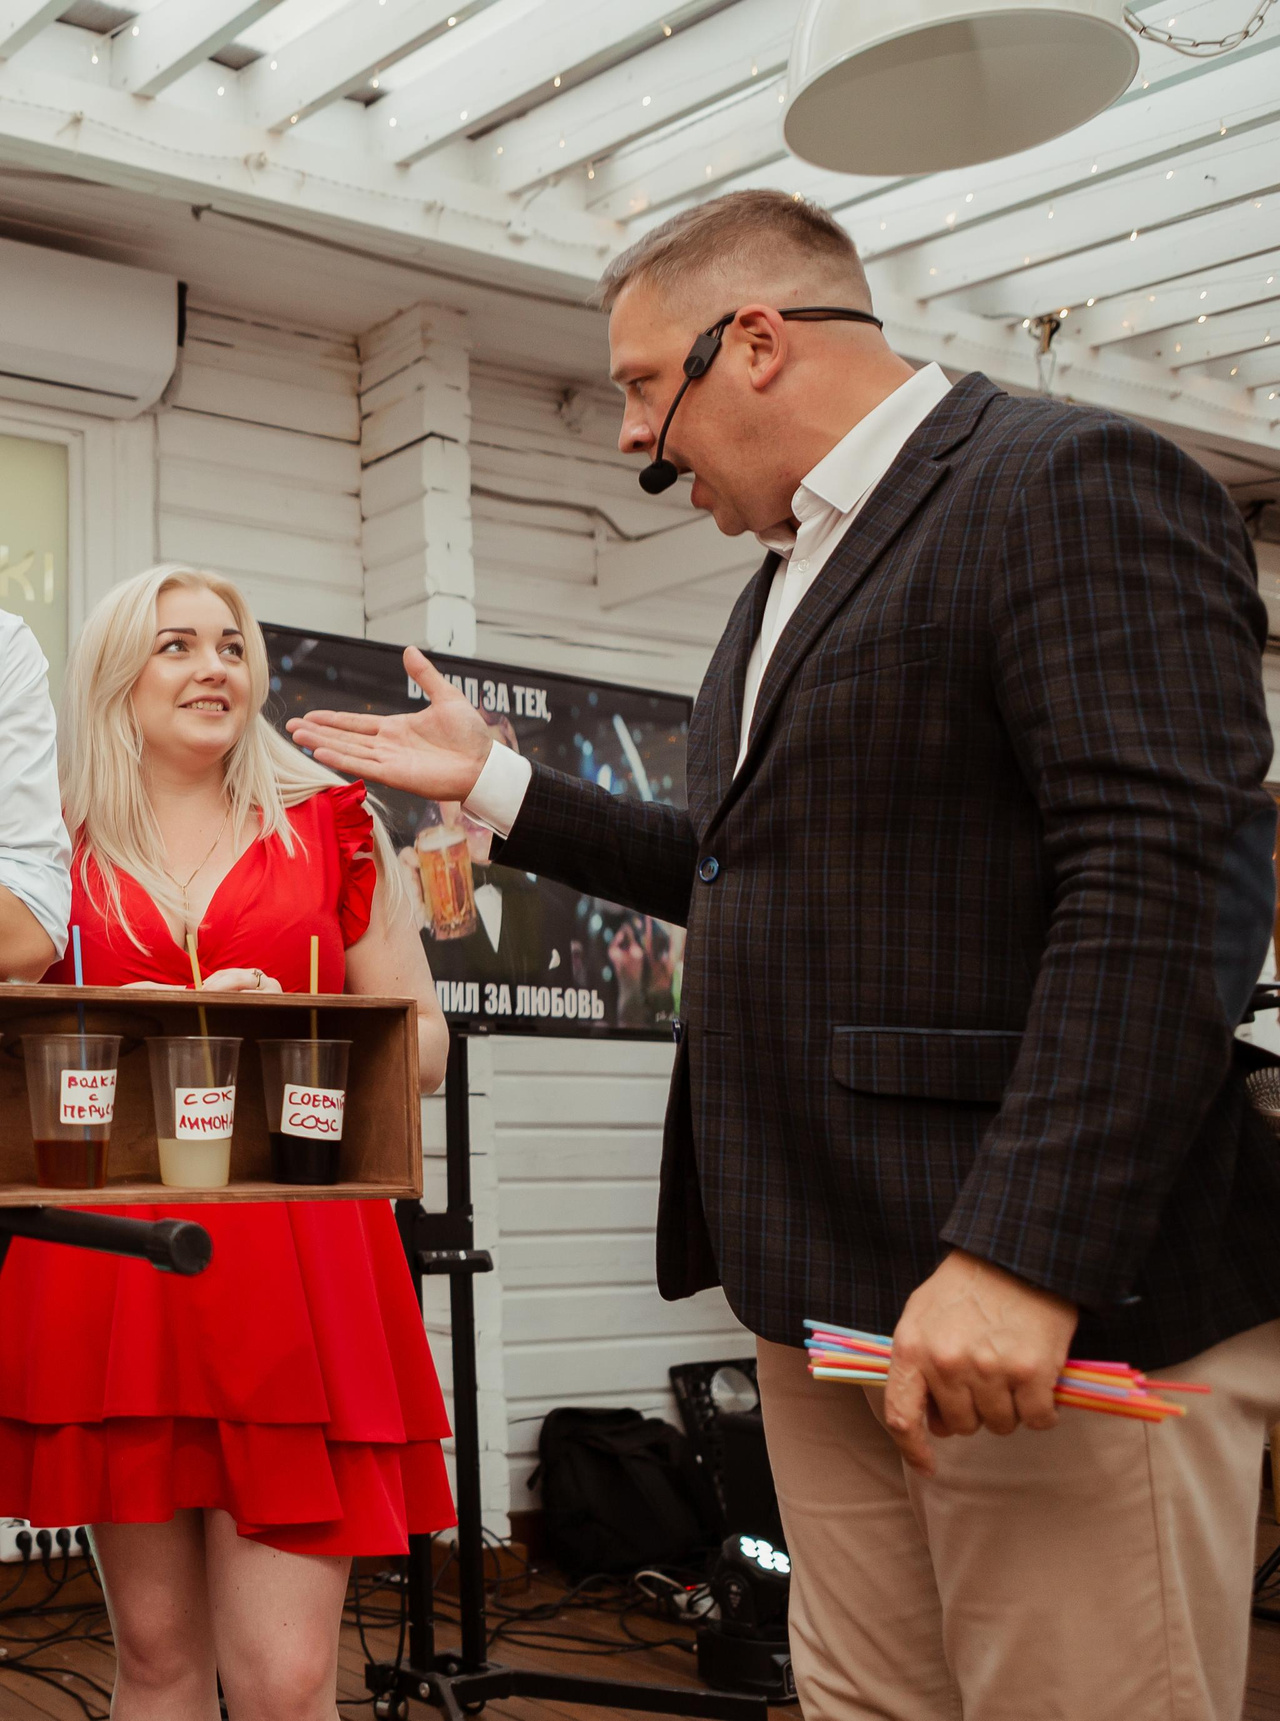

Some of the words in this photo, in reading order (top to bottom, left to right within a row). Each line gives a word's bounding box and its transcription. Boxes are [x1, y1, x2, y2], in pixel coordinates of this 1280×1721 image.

[482, 679, 511, 714] ЗА
[512, 684, 552, 723] ТЕХ,
[484, 983, 513, 1016] ЗА
[515, 984, 606, 1020] ЛЮБОВЬ
[183, 1090, 233, 1106] СОК
[288, 1112, 339, 1133] СОУС
